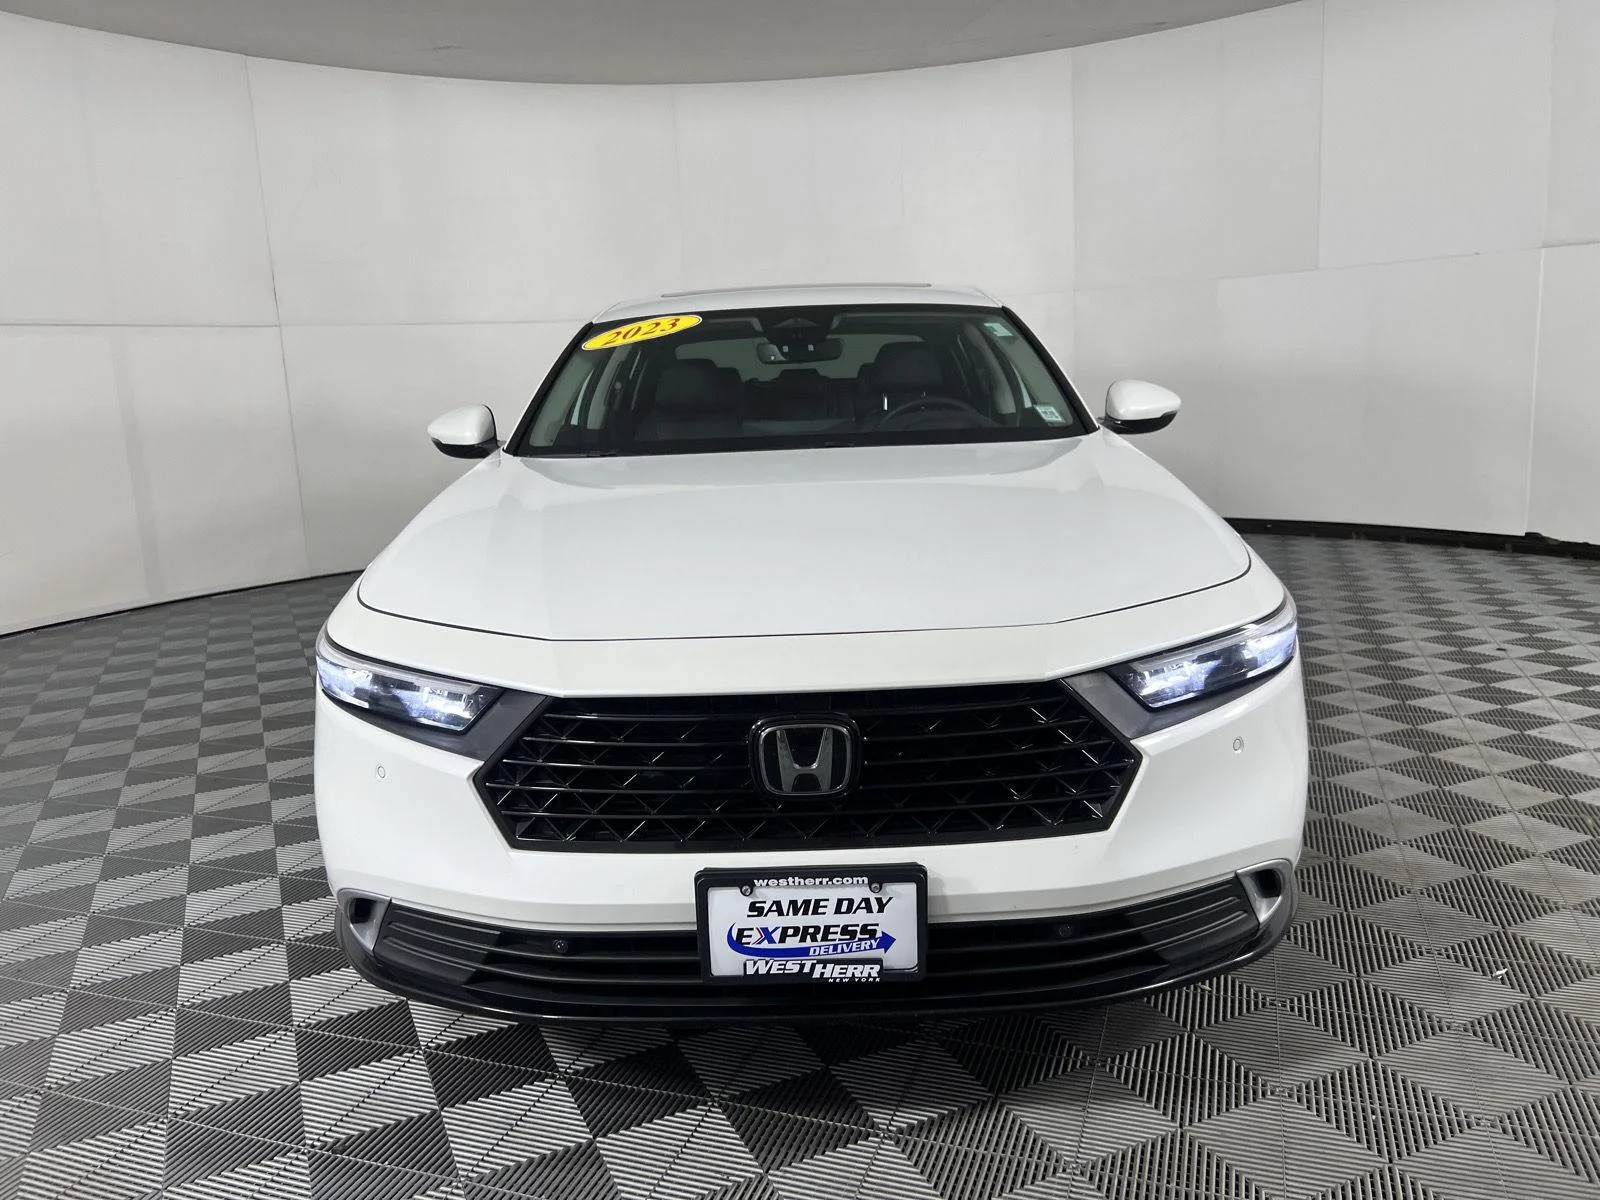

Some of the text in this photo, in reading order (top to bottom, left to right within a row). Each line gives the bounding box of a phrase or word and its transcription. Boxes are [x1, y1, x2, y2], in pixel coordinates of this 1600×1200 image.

[602, 318, 681, 346] 2023
[753, 876, 868, 887] westherr.com
[747, 896, 893, 917] SAME DAY
[736, 923, 879, 945] EXPRESS
[809, 938, 880, 957] DELIVERY
